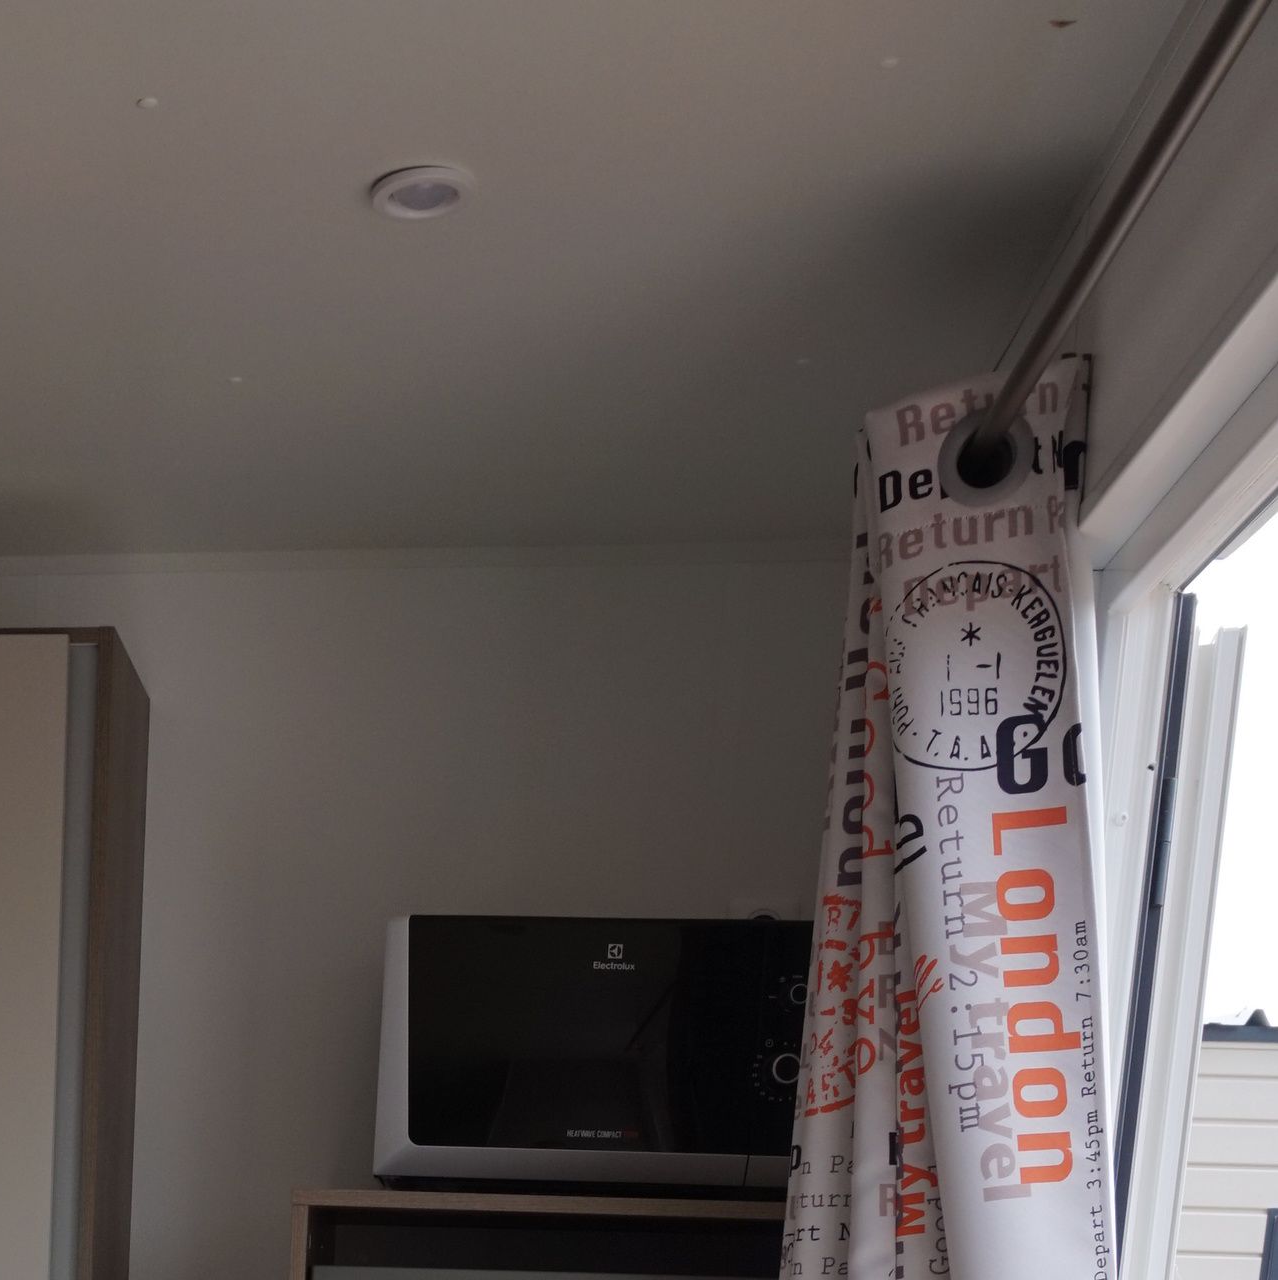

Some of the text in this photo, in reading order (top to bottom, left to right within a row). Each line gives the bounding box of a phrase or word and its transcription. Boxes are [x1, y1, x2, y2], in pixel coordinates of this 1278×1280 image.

[936, 773, 965, 941] Return
[593, 961, 636, 971] Electrolux
[991, 806, 1082, 1186] London
[1072, 919, 1088, 1002] 7:30am
[1079, 1015, 1099, 1098] Return
[1085, 1109, 1105, 1190] 3:45pm
